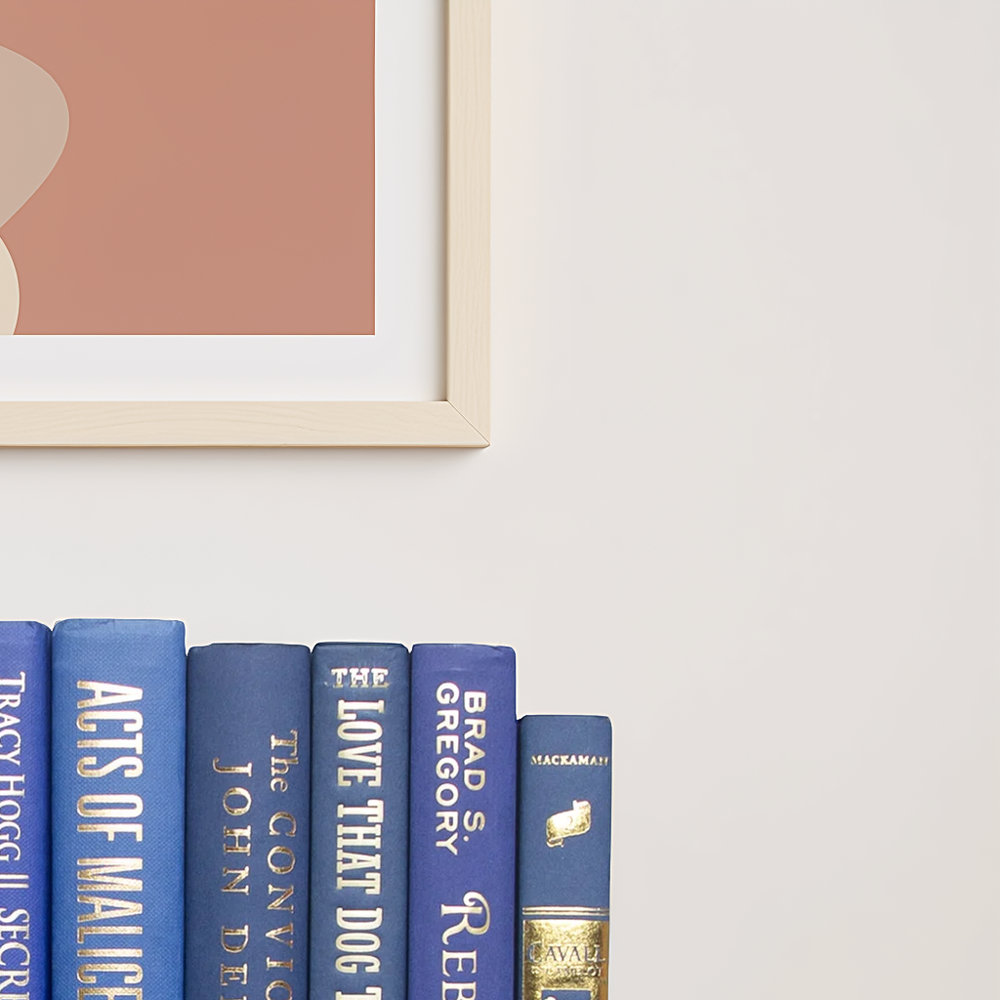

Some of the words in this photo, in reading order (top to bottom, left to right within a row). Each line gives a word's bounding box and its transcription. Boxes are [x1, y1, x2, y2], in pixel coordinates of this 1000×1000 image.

[331, 667, 389, 688] THE
[76, 680, 143, 778] ACTS
[270, 729, 298, 792] The
[337, 700, 385, 787] LOVE
[435, 682, 460, 856] GREGORY
[464, 690, 487, 791] BRAD
[76, 794, 143, 842] OF
[213, 756, 252, 895] JOHN
[336, 799, 384, 895] THAT
[463, 810, 486, 842] S.
[335, 907, 383, 974] DOG
